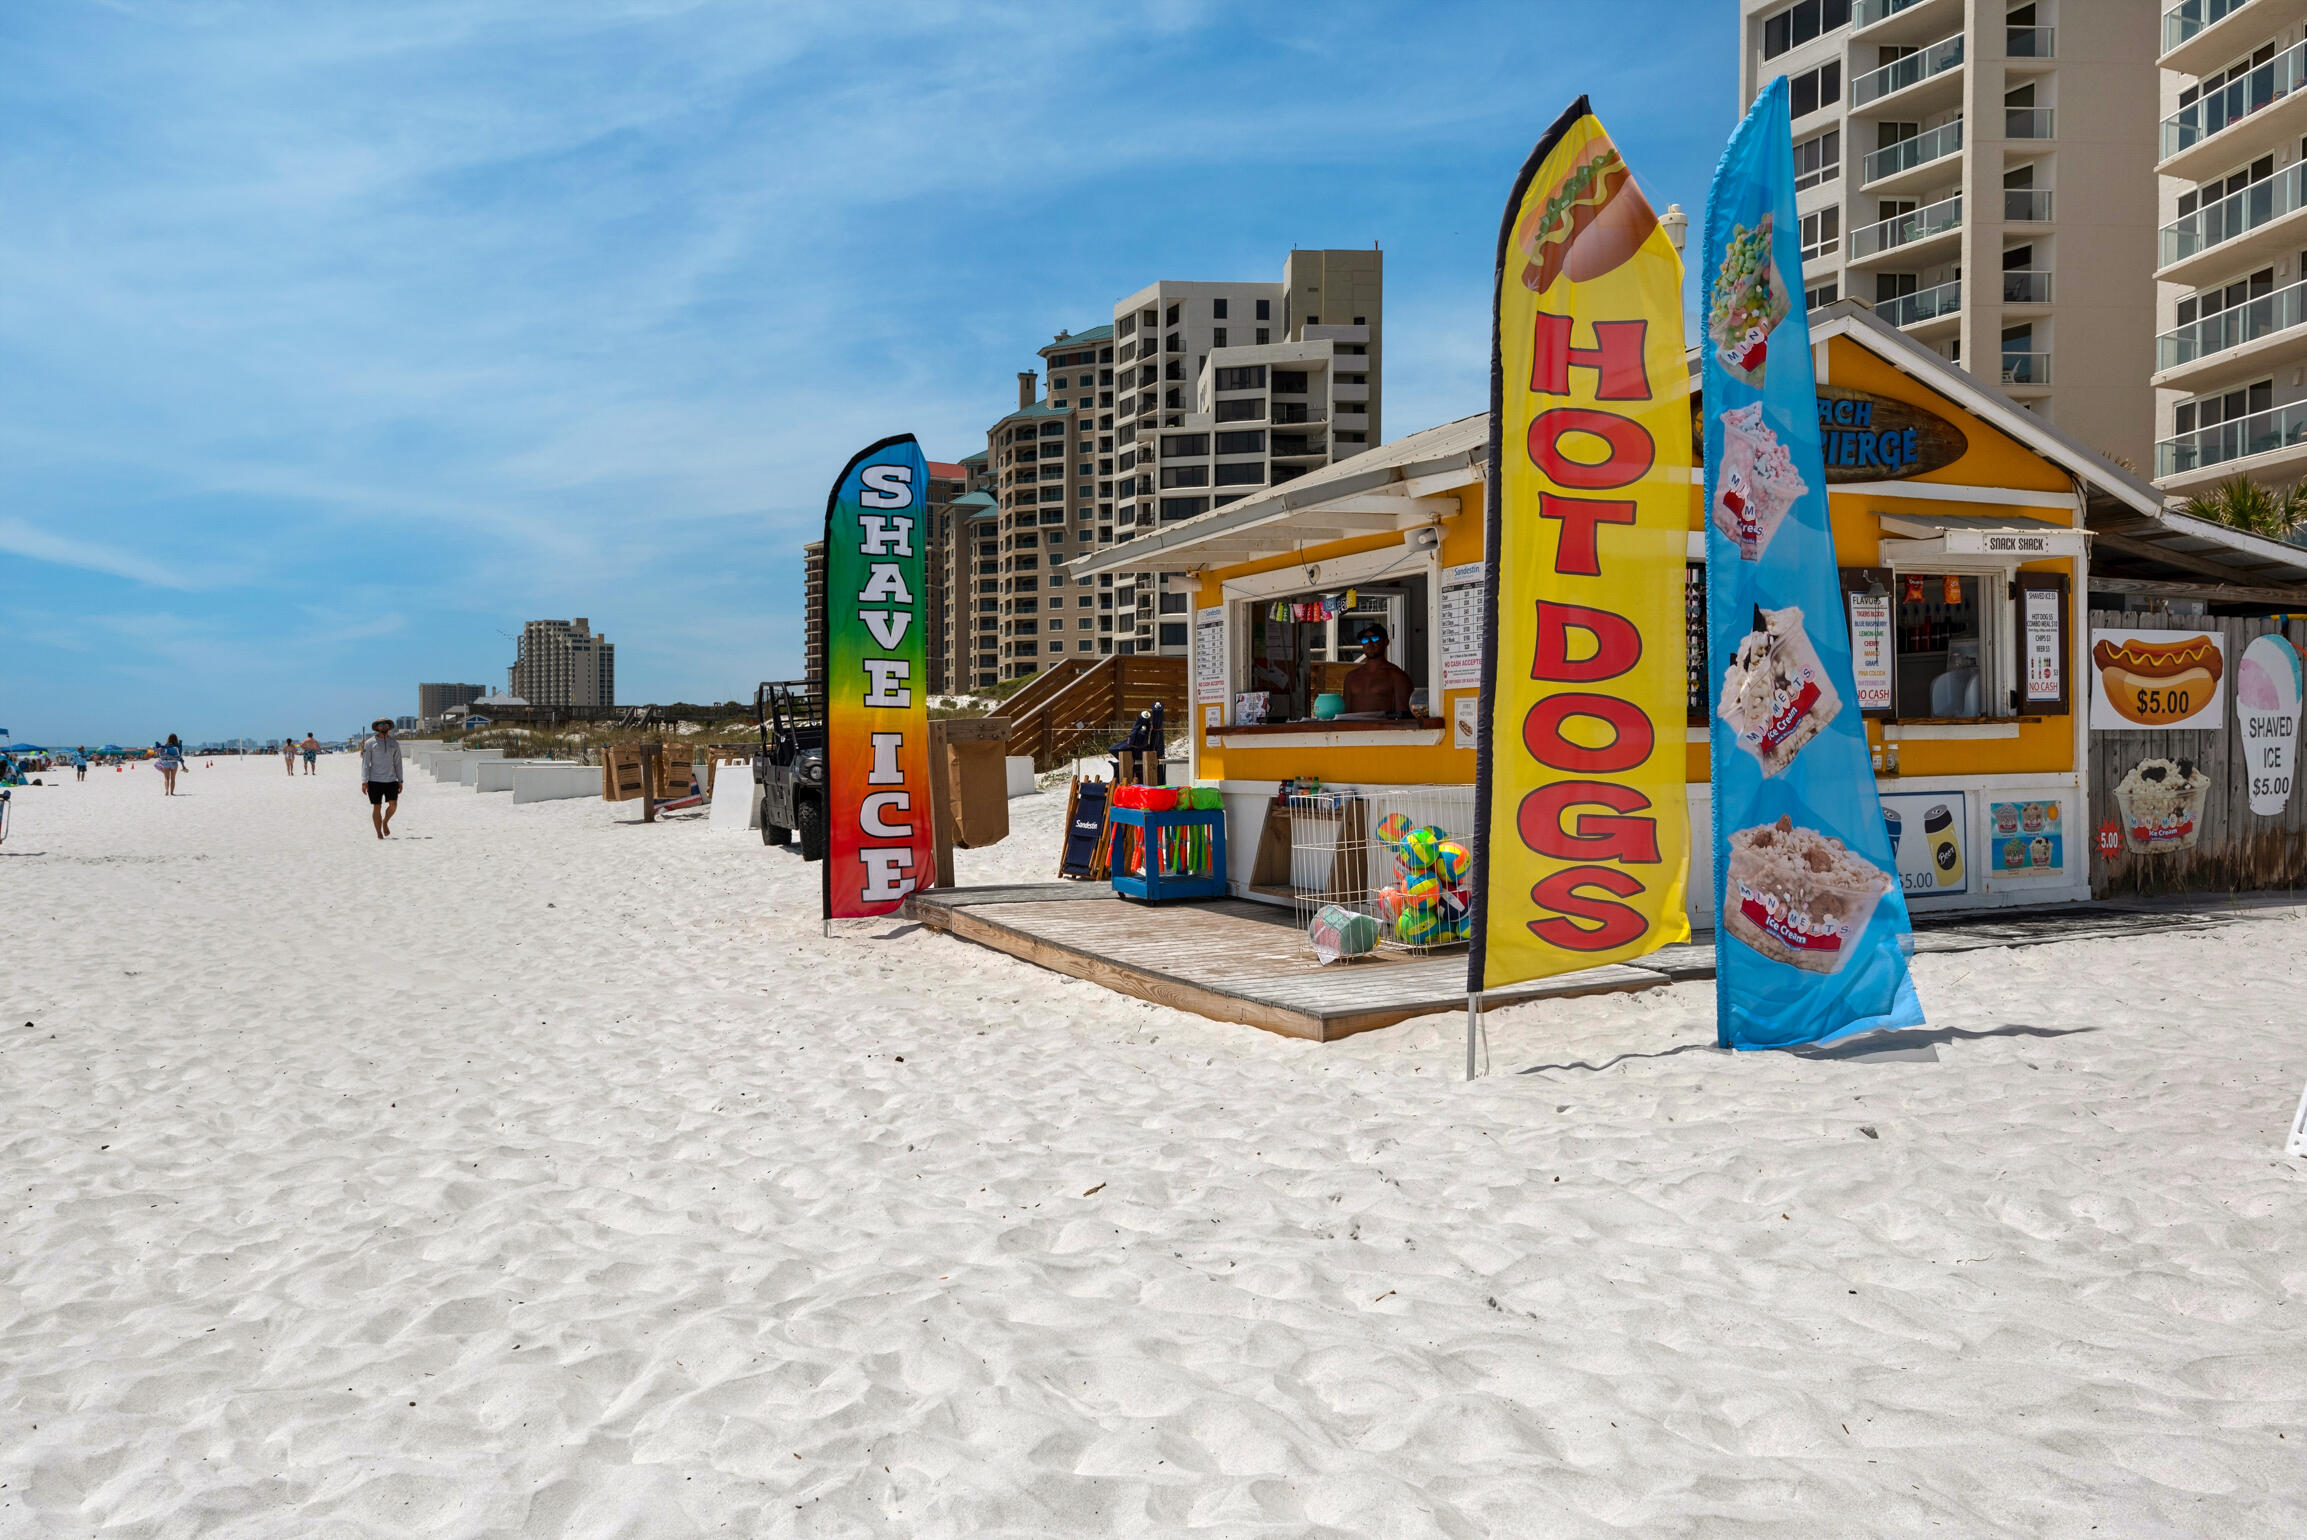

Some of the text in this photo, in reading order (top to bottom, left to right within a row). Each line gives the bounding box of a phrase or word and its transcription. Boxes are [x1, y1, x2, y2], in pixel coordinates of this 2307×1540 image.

[1816, 399, 1873, 427] ACH
[1822, 430, 1918, 472] IERGE
[1990, 537, 2044, 551] SNACK SHACK
[1455, 566, 1480, 577] Sandestin
[1517, 311, 1662, 952] HOT DOGS
[1462, 658, 1483, 666] ACCEPTE
[858, 464, 916, 902] SHAVE ICE
[1773, 668, 1811, 714] MELTS
[2029, 682, 2058, 691] NO CASH
[1868, 689, 1890, 700] CASH
[2137, 688, 2189, 716] $5.00
[1767, 728, 1779, 740] Ice
[1776, 706, 1798, 730] Cream
[2249, 716, 2293, 738] SHAVED
[2263, 747, 2281, 768] ICE
[2252, 777, 2289, 796] $5.00
[1075, 820, 1098, 830] Sandestin
[2100, 832, 2118, 849] 5.00
[1938, 846, 1954, 865] Beer
[1740, 886, 1849, 933] MINI MELTS
[1765, 916, 1779, 932] Ice
[1780, 926, 1807, 944] Cream
